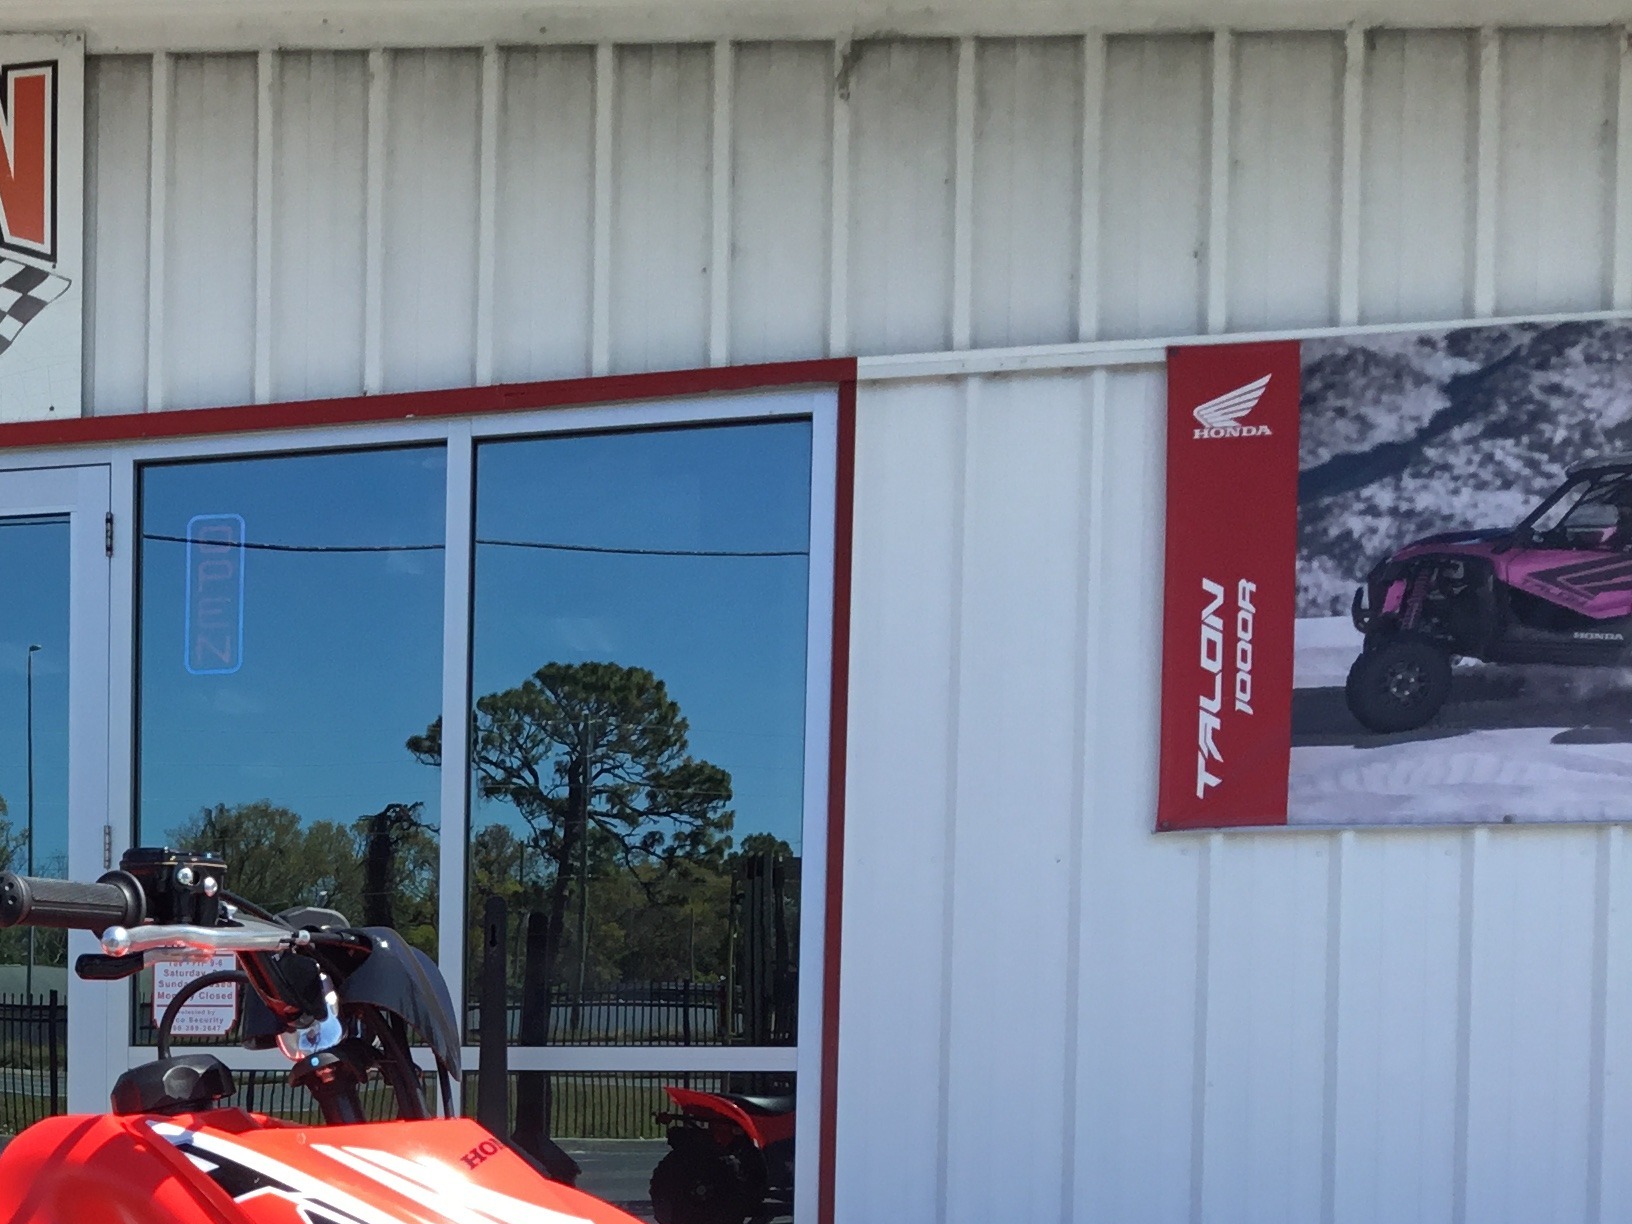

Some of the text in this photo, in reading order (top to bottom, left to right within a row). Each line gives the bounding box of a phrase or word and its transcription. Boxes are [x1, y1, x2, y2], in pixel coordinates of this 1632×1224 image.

[1193, 425, 1272, 439] HONDA
[1573, 632, 1624, 640] HONDA
[1234, 578, 1257, 715] 1000R
[1197, 577, 1225, 799] TALON
[199, 991, 233, 1000] Closed
